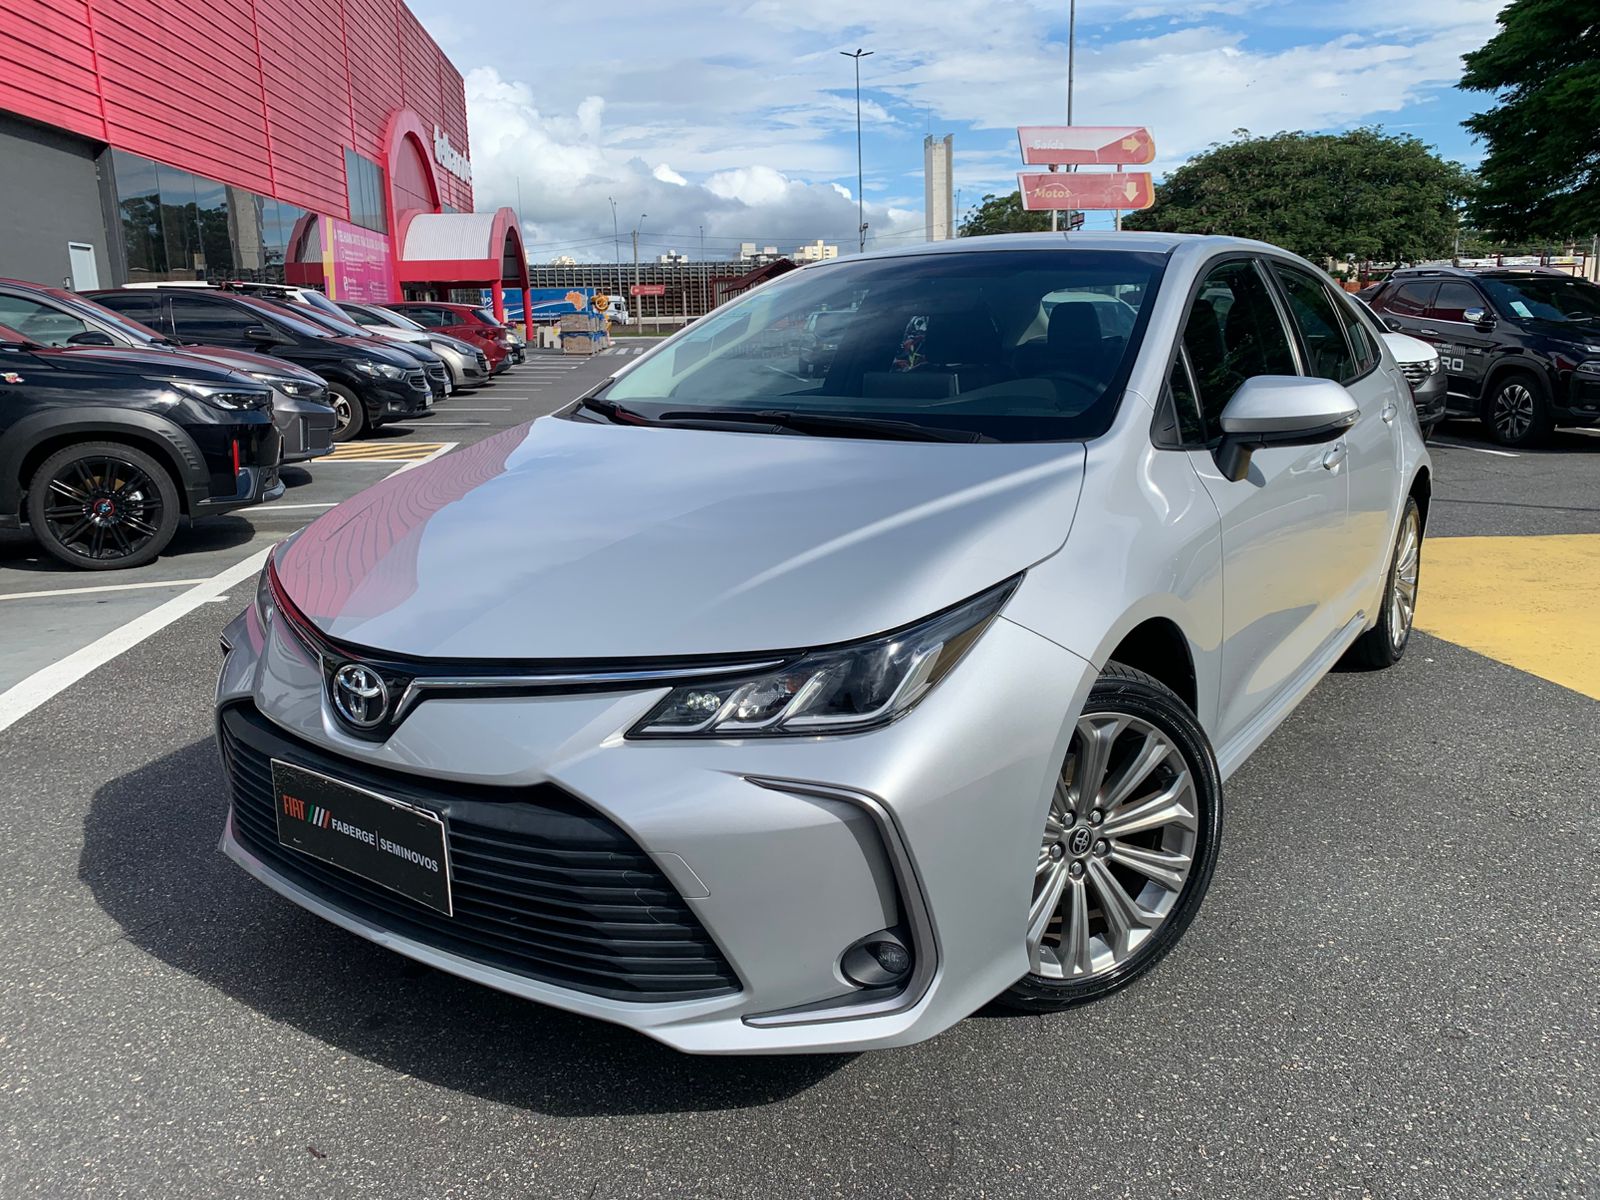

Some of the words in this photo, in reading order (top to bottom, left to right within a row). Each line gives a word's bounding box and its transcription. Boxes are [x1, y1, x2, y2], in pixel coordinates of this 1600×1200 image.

[1034, 187, 1071, 199] Motos
[1440, 356, 1464, 372] RO
[282, 794, 305, 821] FIAT
[331, 818, 376, 847] FABERGE
[380, 838, 439, 873] SEMINOVOS
